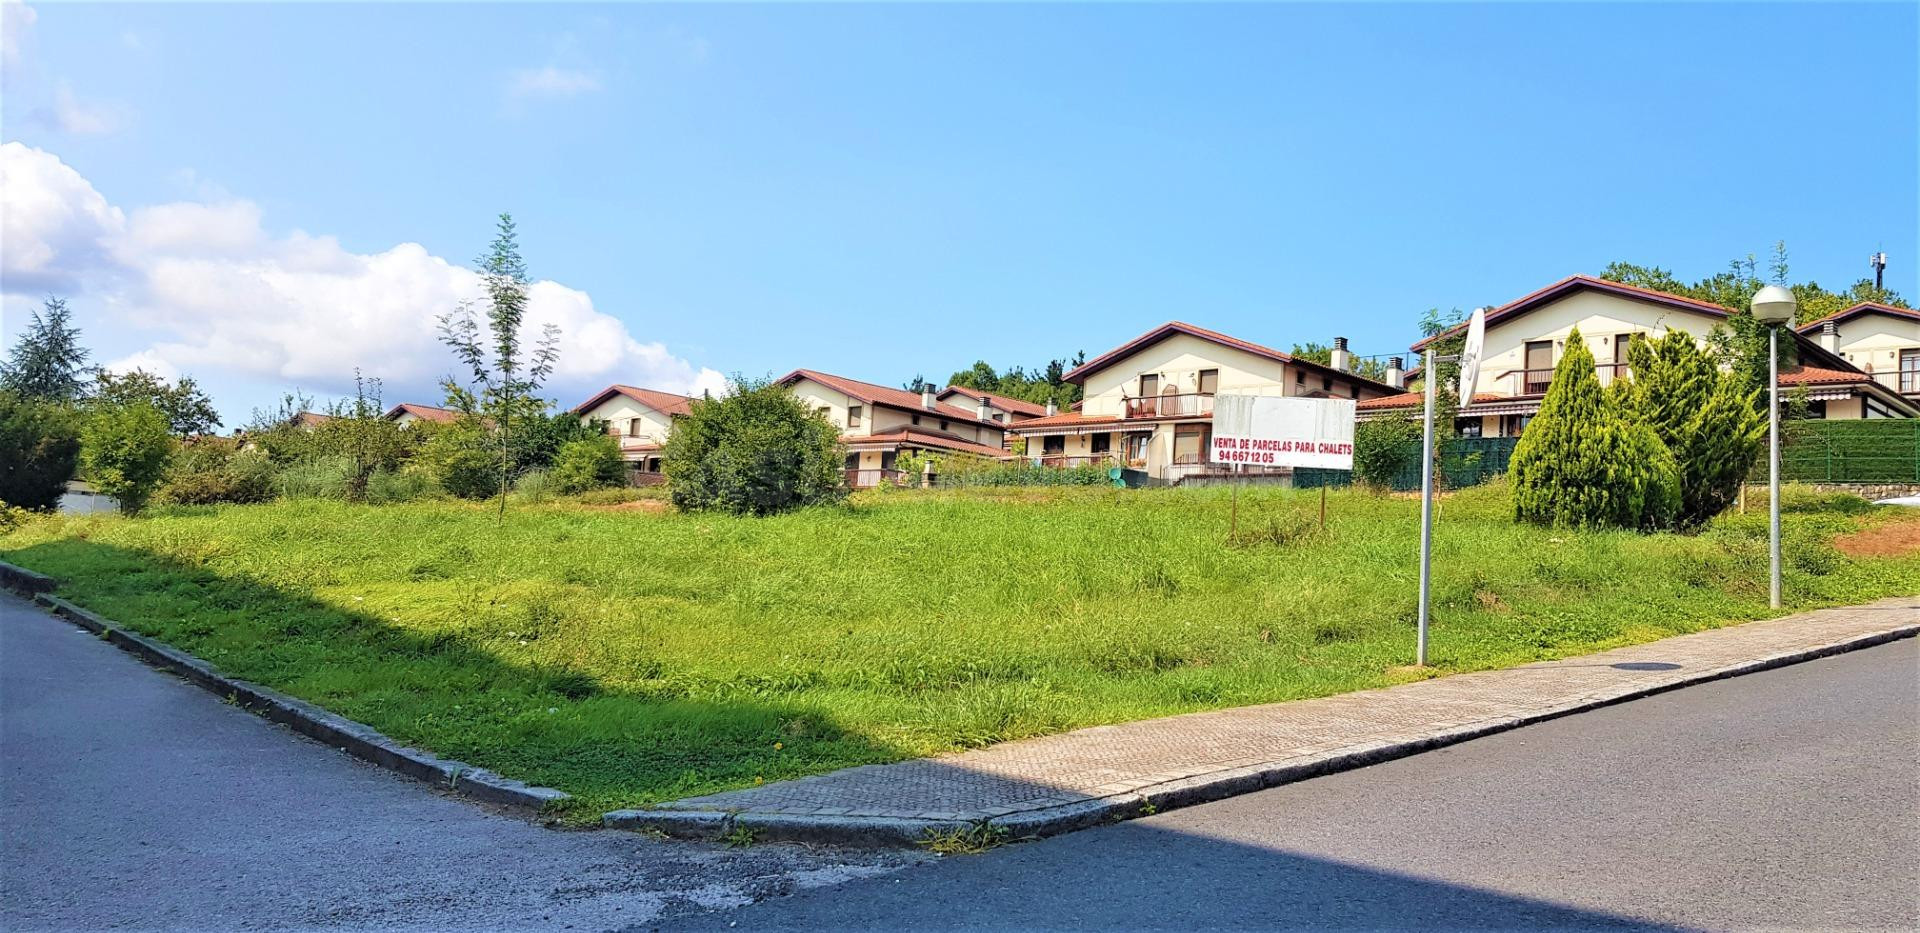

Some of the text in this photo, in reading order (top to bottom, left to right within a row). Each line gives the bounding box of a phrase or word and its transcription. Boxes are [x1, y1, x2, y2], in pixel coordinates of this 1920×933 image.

[1213, 437, 1352, 455] VENTA DE PARCELAS PARA CHALETS
